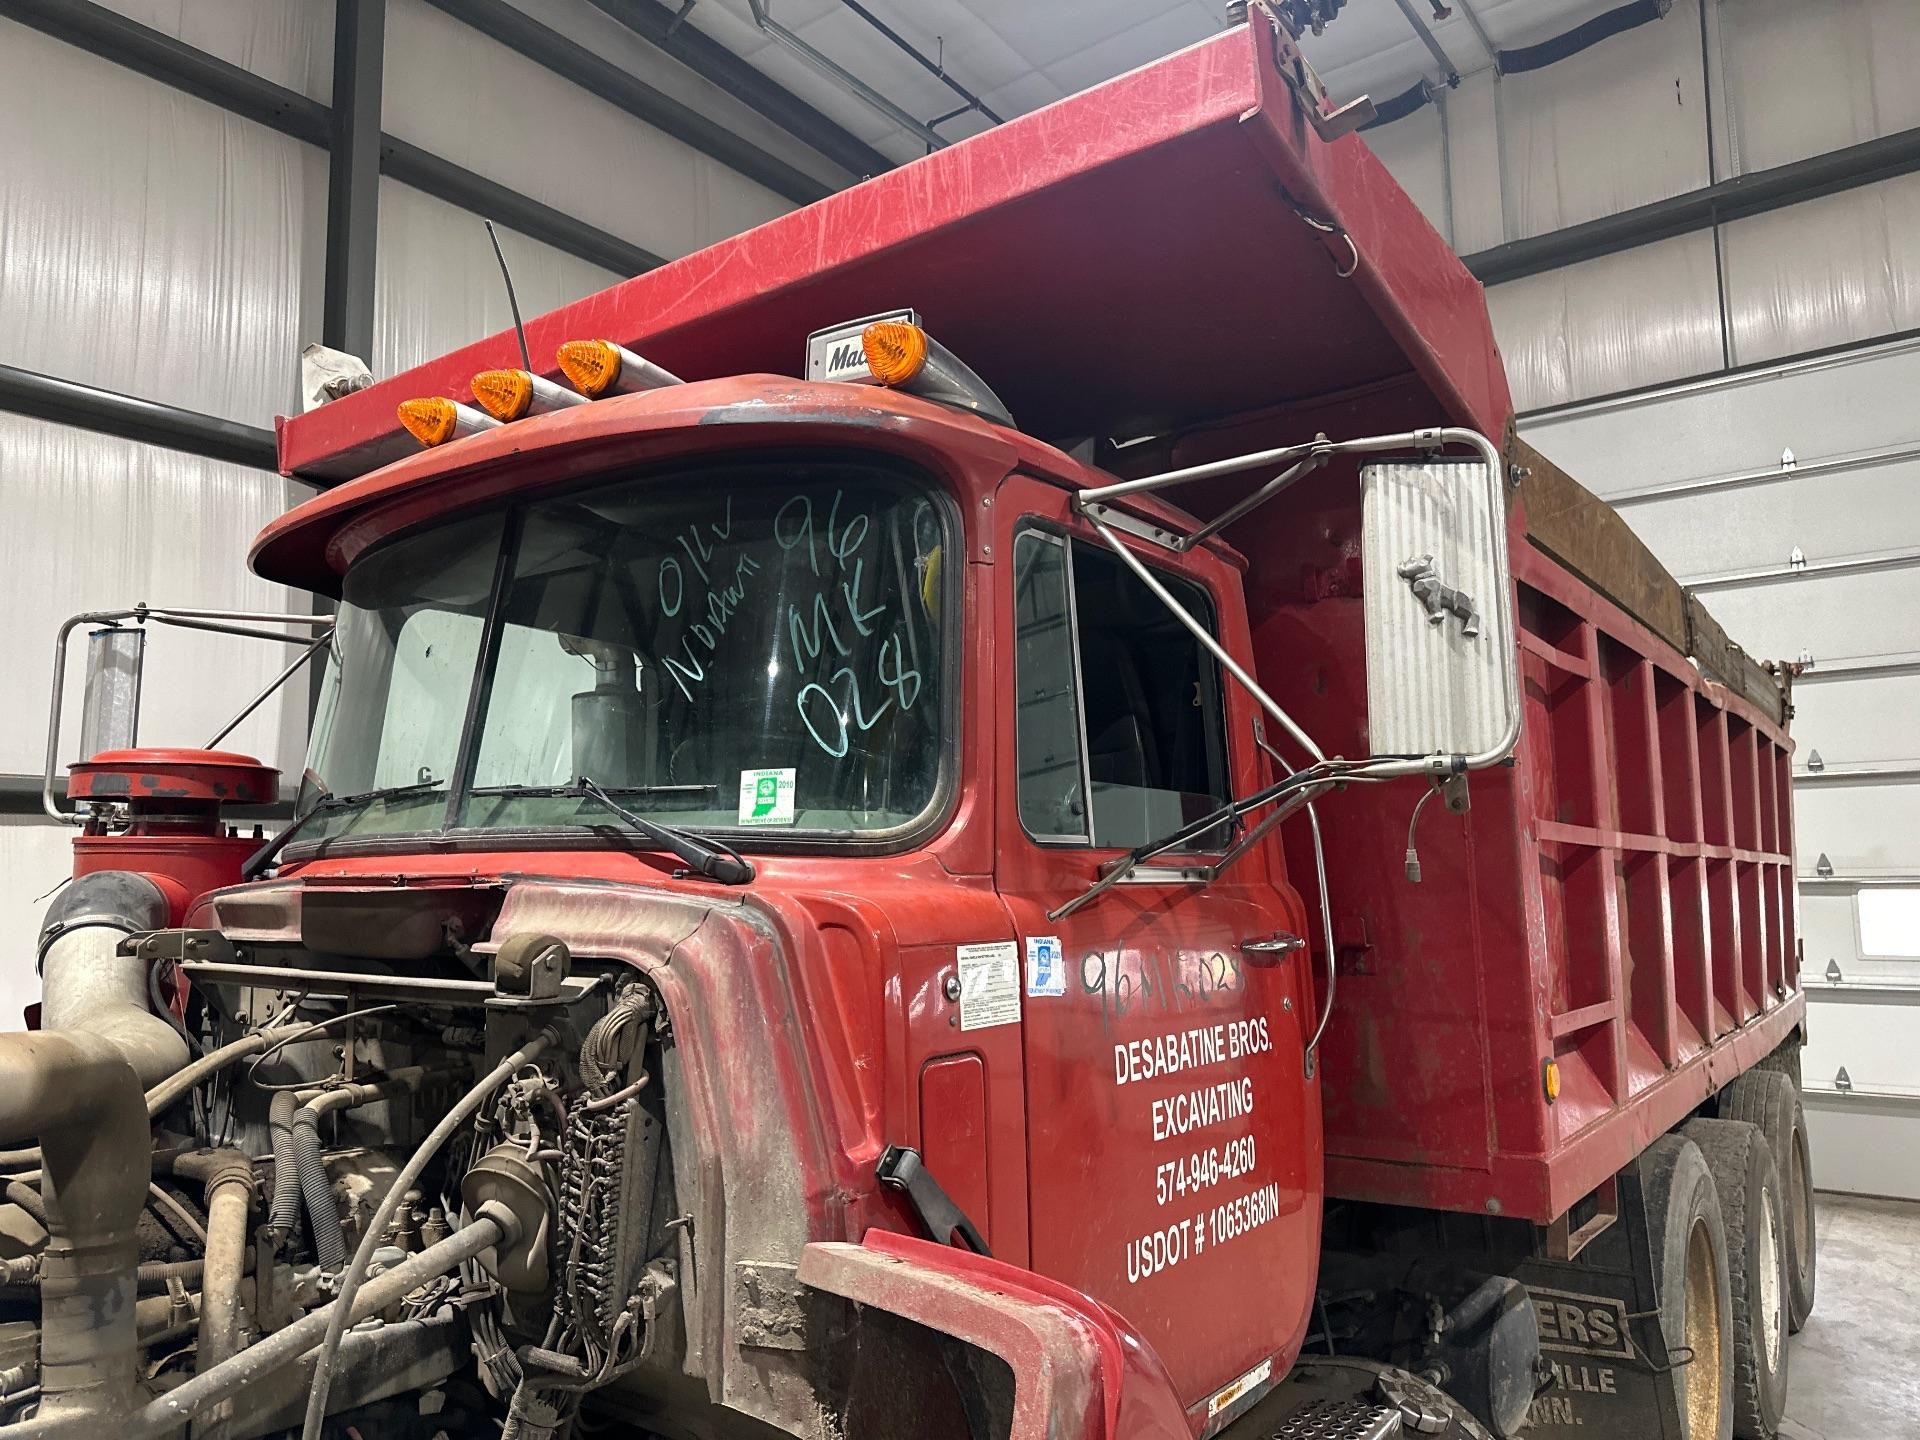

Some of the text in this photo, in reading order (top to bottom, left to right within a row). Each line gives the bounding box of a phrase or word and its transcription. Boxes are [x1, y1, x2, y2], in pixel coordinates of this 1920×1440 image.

[775, 489, 868, 577] 96
[789, 557, 886, 673] MK
[798, 632, 921, 757] 028
[1115, 1016, 1273, 1085] DESABATINE BROS.
[1152, 1077, 1254, 1141] EXCAVATING
[1156, 1134, 1256, 1206] 574-946-4260
[1127, 1182, 1279, 1284] USDOT # 1065368IN
